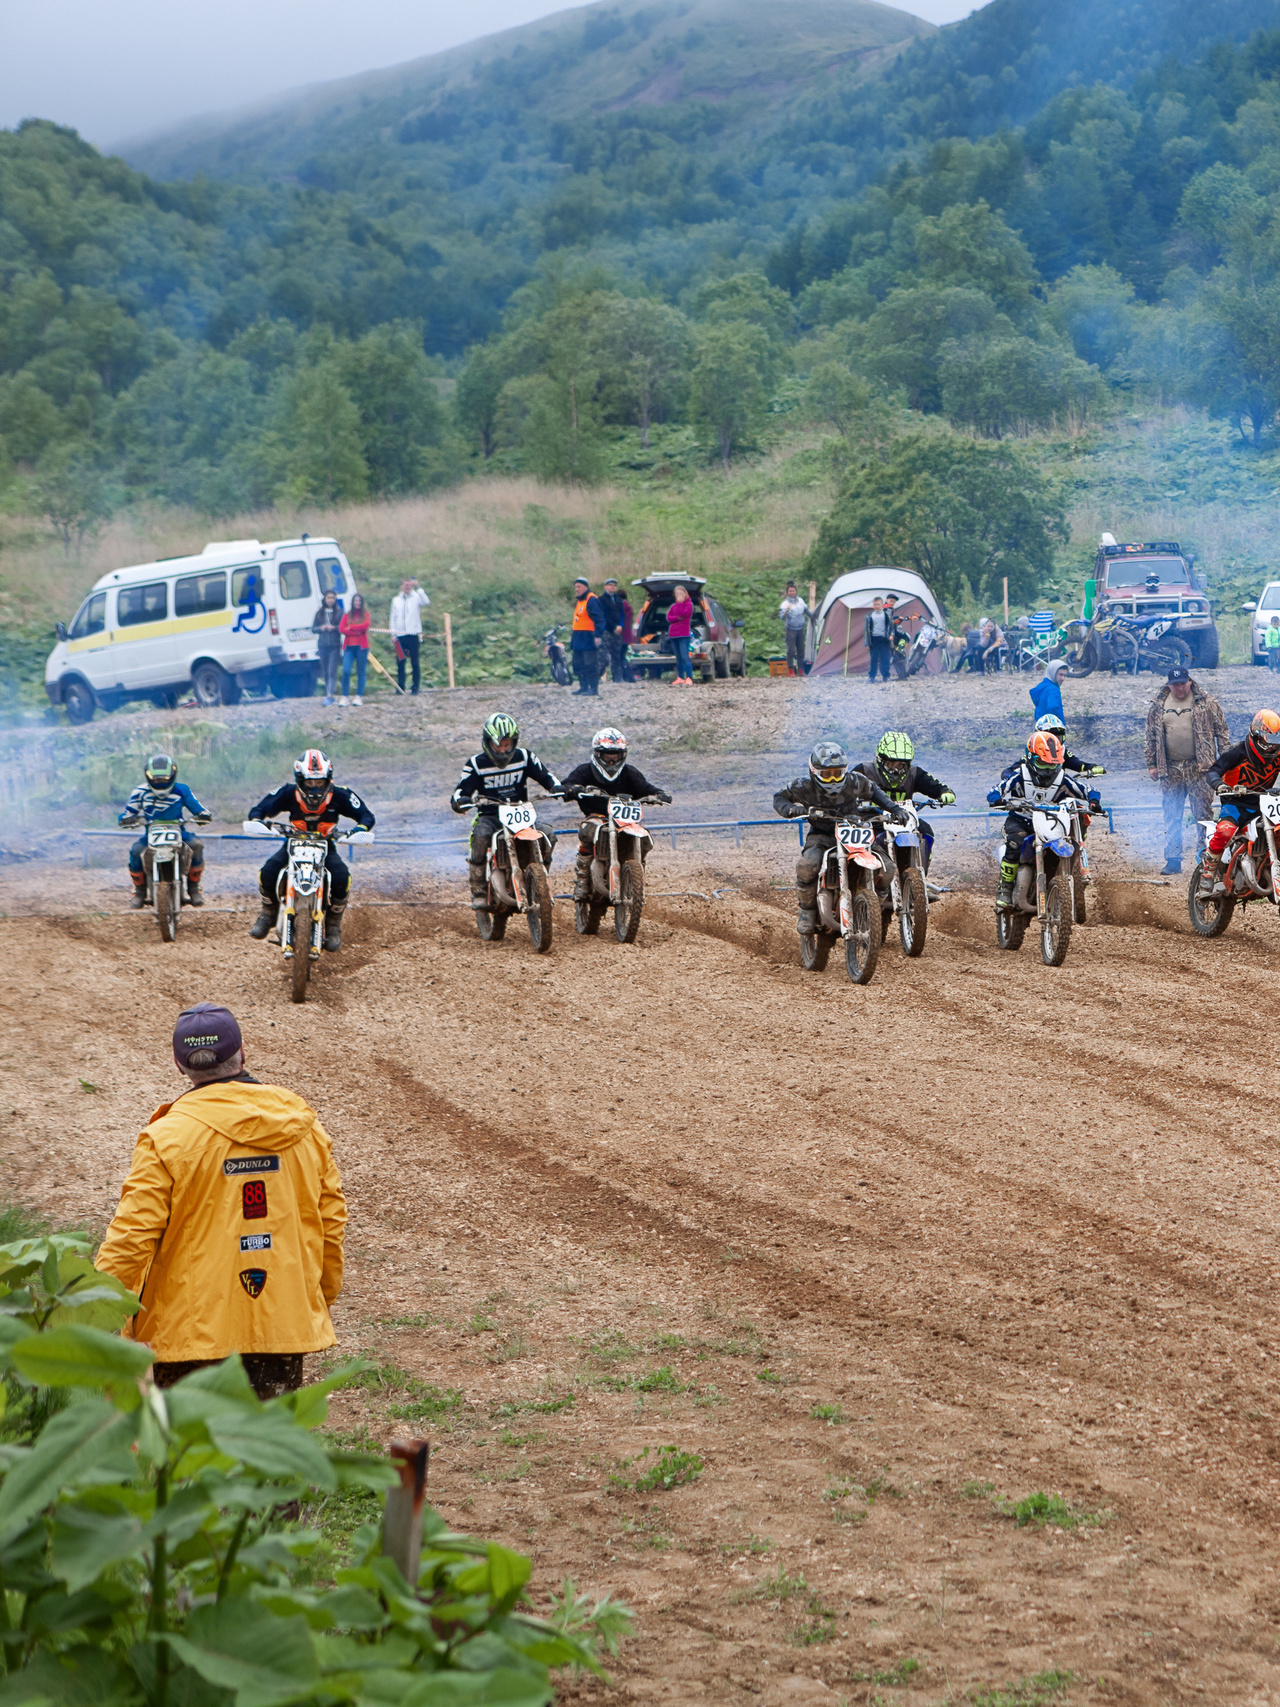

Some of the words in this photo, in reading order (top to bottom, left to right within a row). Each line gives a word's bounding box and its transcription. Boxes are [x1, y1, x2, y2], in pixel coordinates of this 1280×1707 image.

[1153, 624, 1163, 637] 27
[484, 770, 524, 789] SHIFT
[506, 810, 531, 825] 208
[612, 806, 641, 821] 205
[152, 831, 179, 844] 70
[840, 829, 872, 844] 202
[184, 1035, 219, 1044] MONSTER
[238, 1160, 271, 1170] DUNLO
[245, 1183, 265, 1205] 88
[242, 1237, 270, 1247] TURBO
